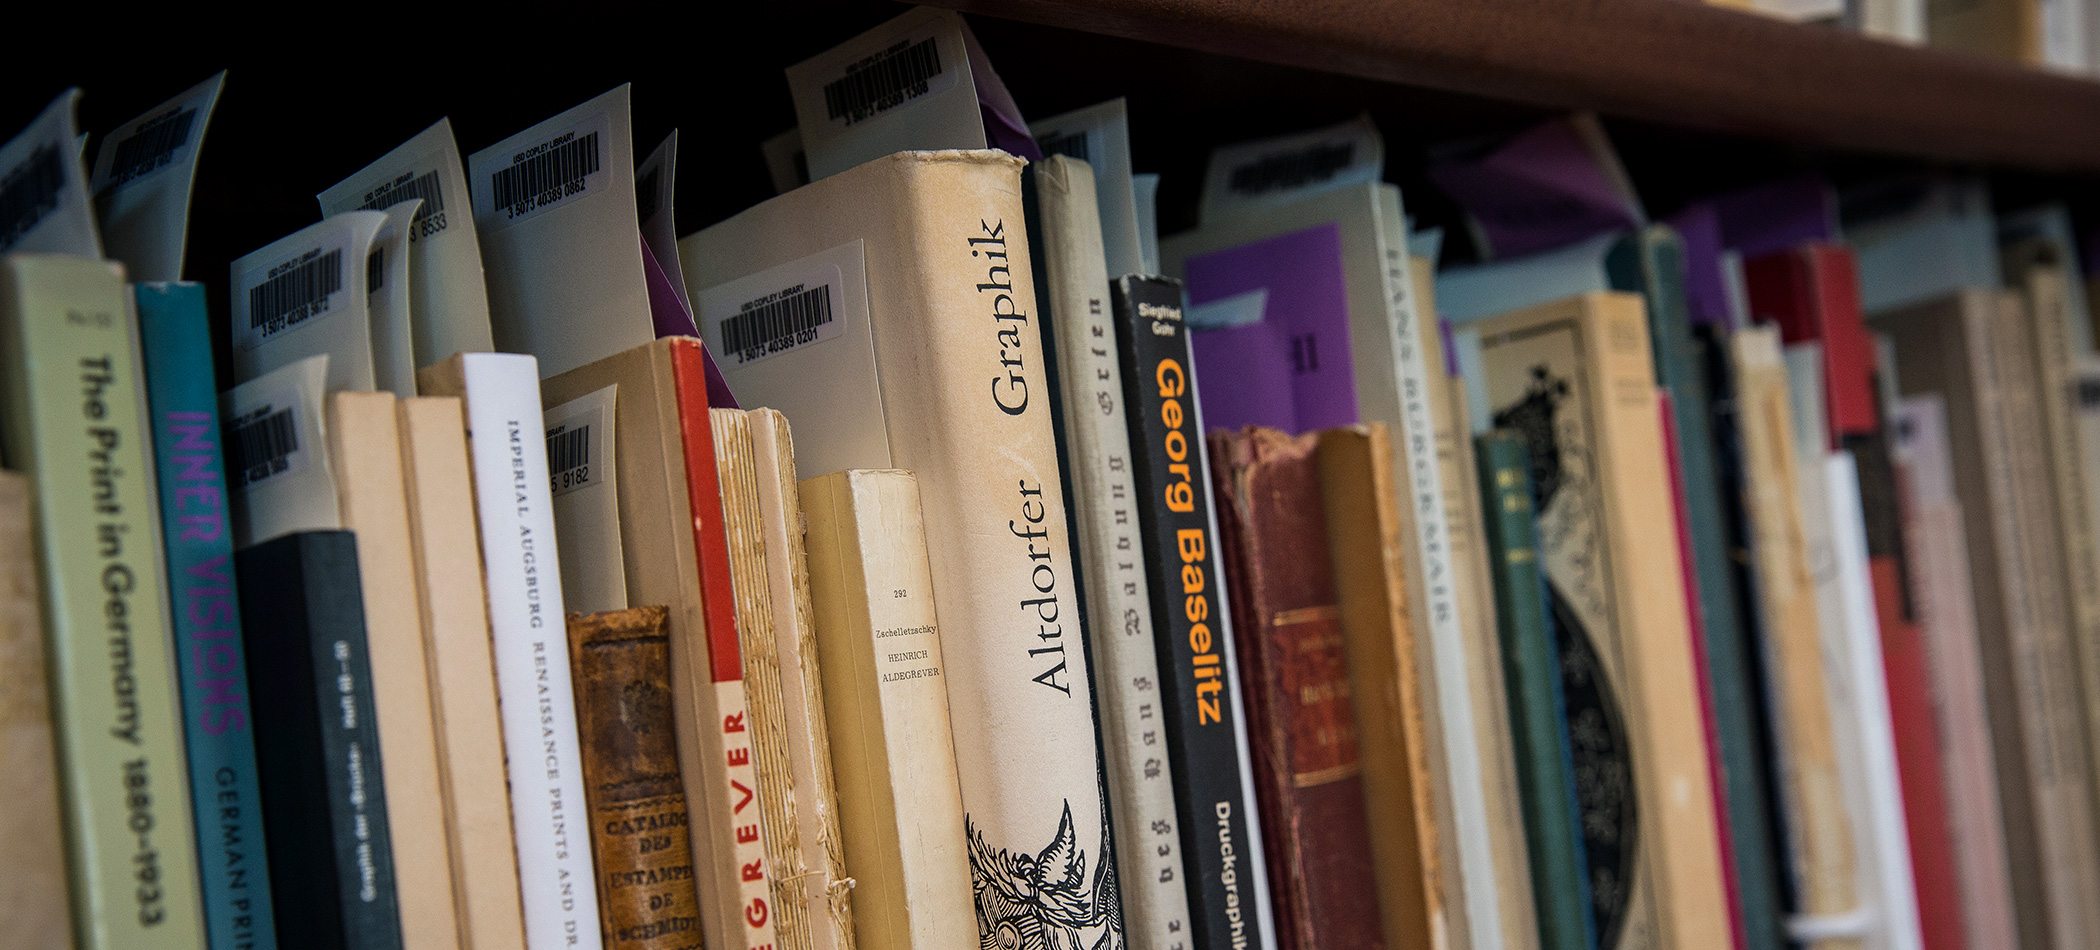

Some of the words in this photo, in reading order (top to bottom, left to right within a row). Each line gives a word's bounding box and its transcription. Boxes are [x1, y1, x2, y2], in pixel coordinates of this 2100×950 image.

[906, 81, 928, 99] 1308
[513, 153, 525, 164] USD
[526, 142, 548, 158] COPLEY
[550, 131, 575, 148] LIBRARY
[375, 182, 392, 196] COPLEY
[393, 170, 414, 187] LIBRARY
[515, 198, 535, 216] 5073
[537, 186, 562, 207] 40389
[564, 177, 585, 197] 0862
[421, 213, 447, 237] 8533
[754, 292, 777, 307] COPLEY
[778, 283, 804, 299] LIBRARY
[967, 218, 1029, 416] Graphik
[745, 345, 766, 362] 5073
[768, 335, 795, 355] 40389
[796, 327, 818, 345] 0201
[79, 357, 115, 421] The
[86, 427, 124, 515] Print
[166, 412, 224, 542] INNER
[507, 419, 529, 518] IMPERIAL
[564, 466, 588, 488] 9182
[96, 523, 130, 558] in
[1109, 455, 1141, 636] Baldung
[1156, 358, 1195, 513] Georg
[1177, 528, 1223, 726] Baselitz
[519, 525, 544, 630] AUGSBURG
[893, 589, 907, 598] 292
[1009, 479, 1071, 699] Altdorfer
[102, 562, 143, 747] Germany
[186, 554, 246, 736] VISIONS
[876, 625, 937, 639] Zschelletzschky
[882, 667, 940, 682] ALDEGREVER
[888, 650, 928, 662] HEINRICH
[532, 641, 560, 780] RENAISSANCE
[215, 766, 248, 893] GERMAN
[549, 787, 569, 861] PRINTS
[639, 836, 672, 855] DES
[558, 868, 575, 913] AND
[650, 893, 674, 911] DE
[231, 898, 254, 950] PRI
